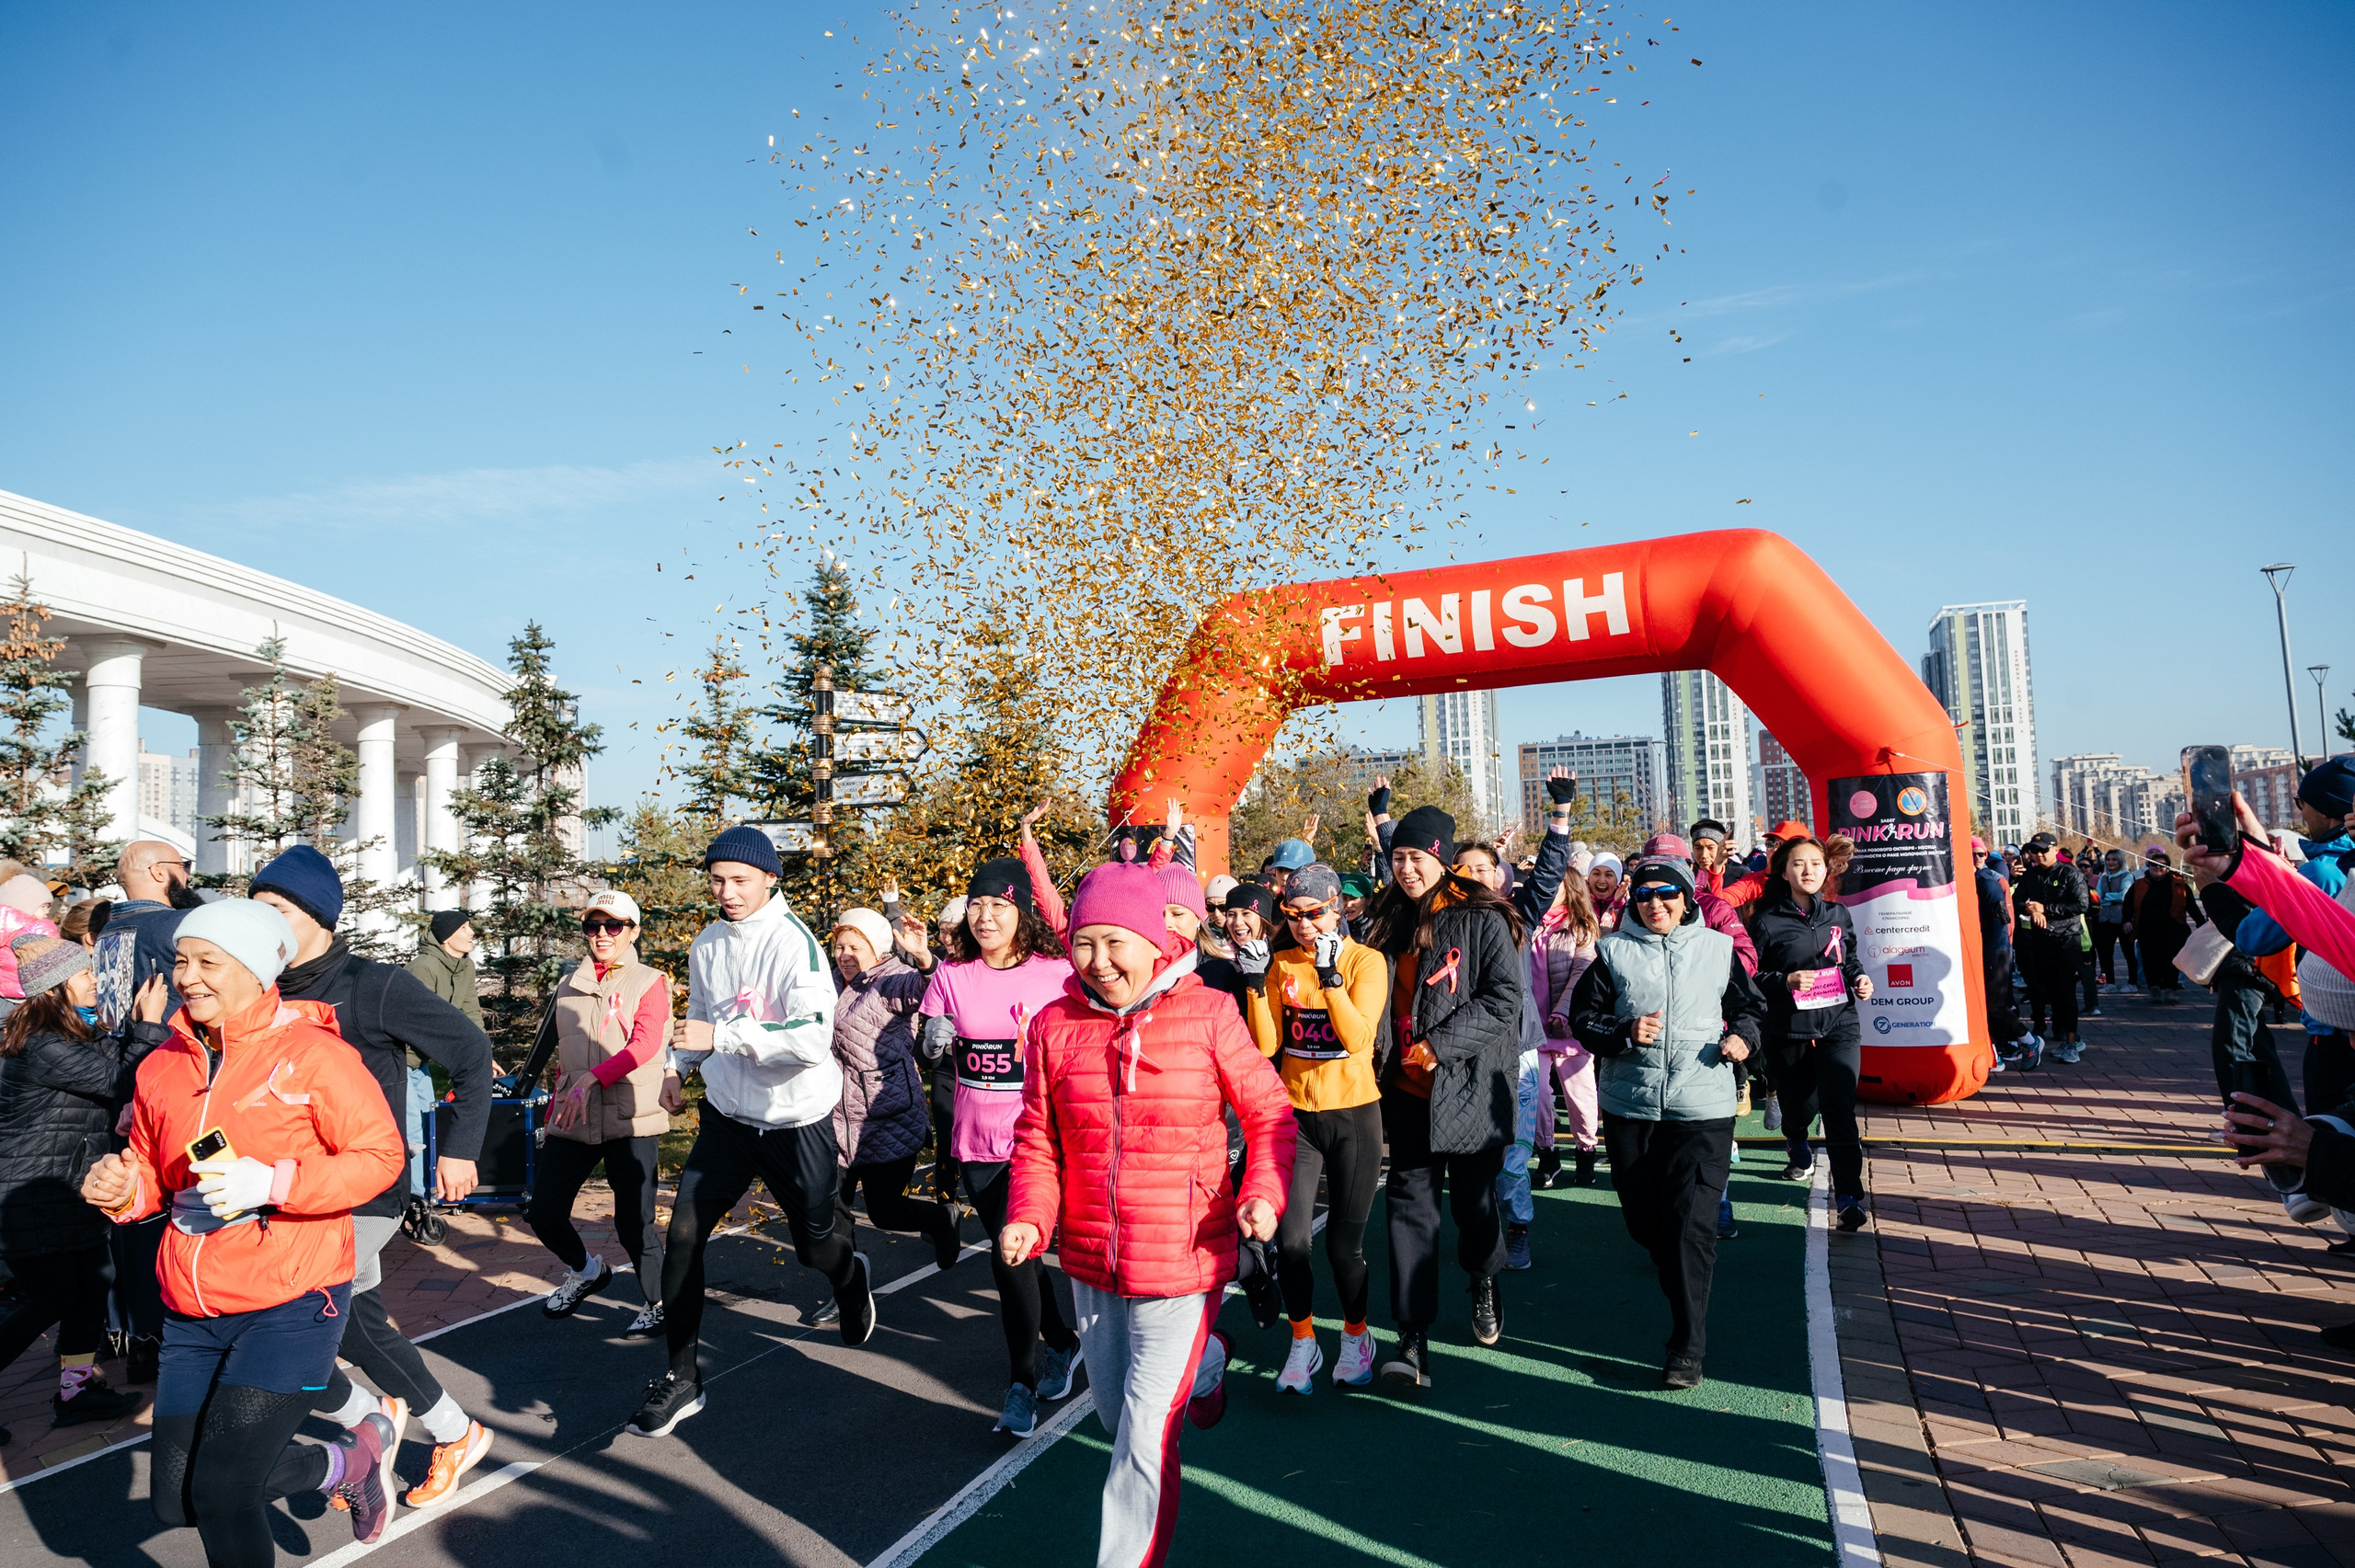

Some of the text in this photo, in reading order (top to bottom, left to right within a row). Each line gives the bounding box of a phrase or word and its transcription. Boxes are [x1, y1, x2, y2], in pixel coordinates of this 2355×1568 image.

[1321, 572, 1630, 666] FINISH
[1896, 821, 1945, 841] RUN
[1876, 925, 1930, 934] centercredit
[1882, 945, 1925, 956] alageum
[1871, 997, 1935, 1006] DEM GROUP
[1291, 1021, 1338, 1042] 040
[966, 1052, 1012, 1073] 055
[214, 1132, 226, 1148] POCO
